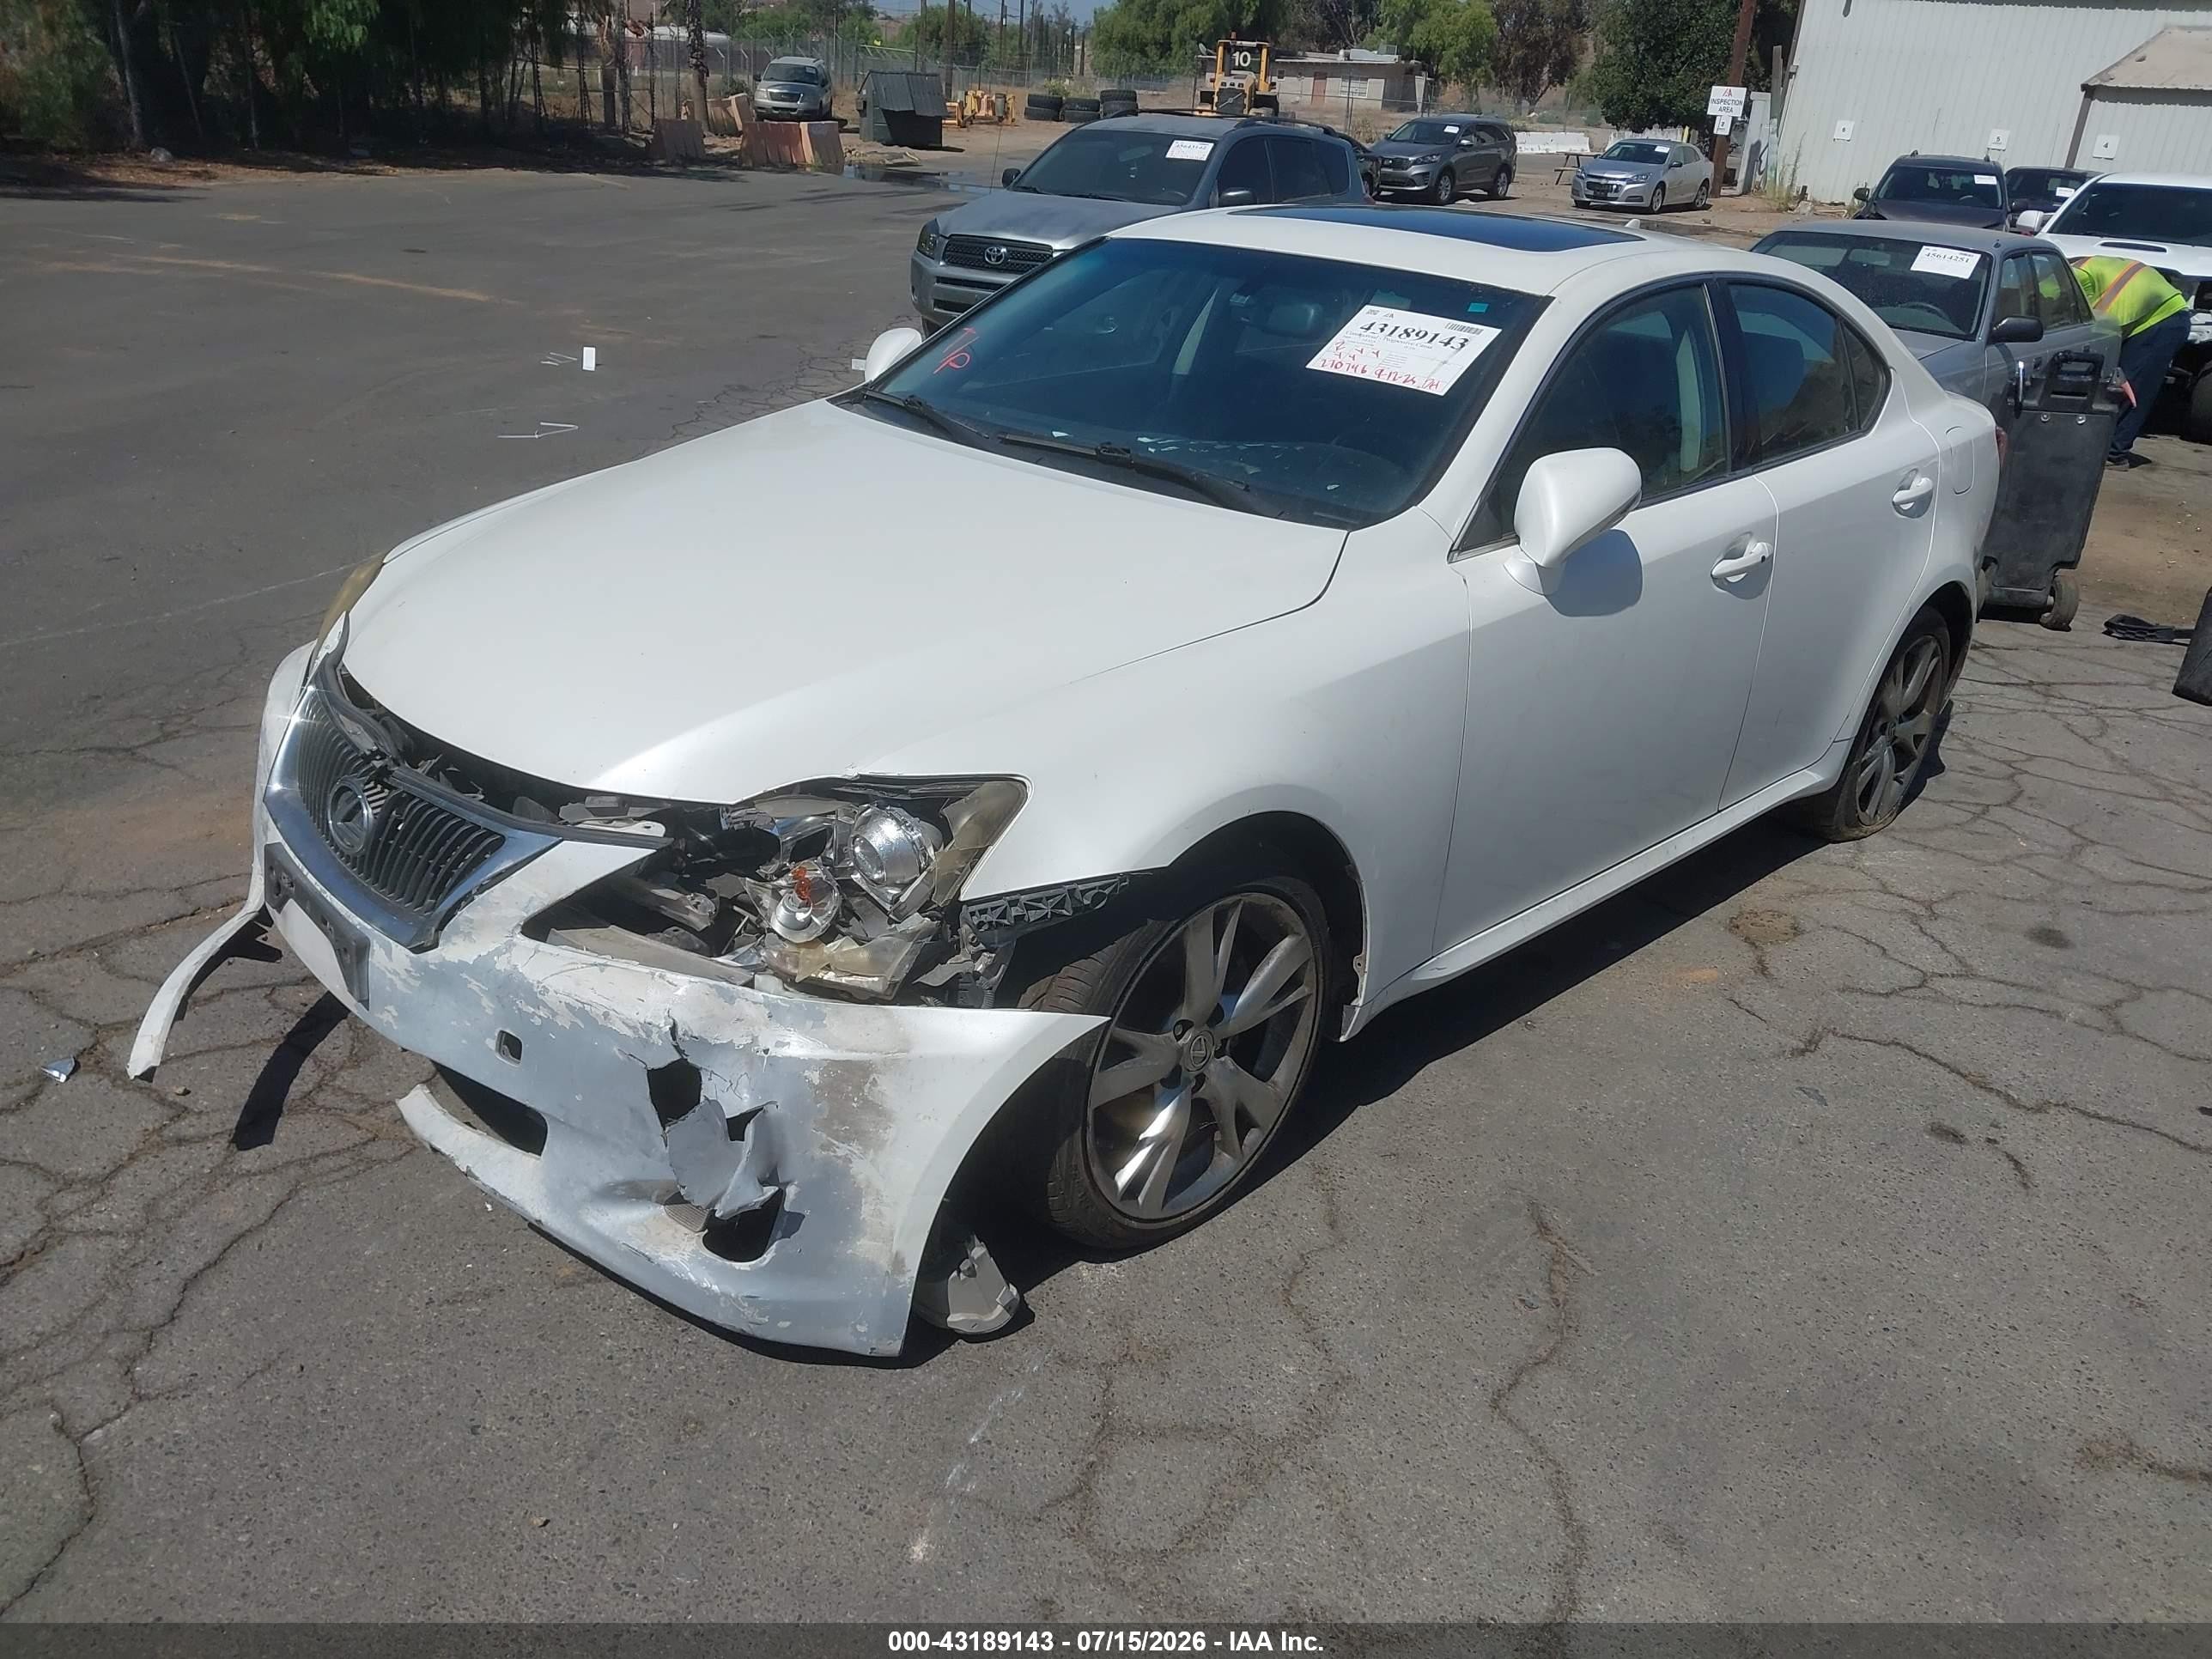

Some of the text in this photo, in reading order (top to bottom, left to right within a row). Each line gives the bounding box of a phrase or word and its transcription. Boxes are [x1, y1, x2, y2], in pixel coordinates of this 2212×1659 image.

[1232, 51, 1251, 67] 10
[1710, 98, 1743, 106] INSPECTION
[1359, 320, 1471, 351] 43189143
